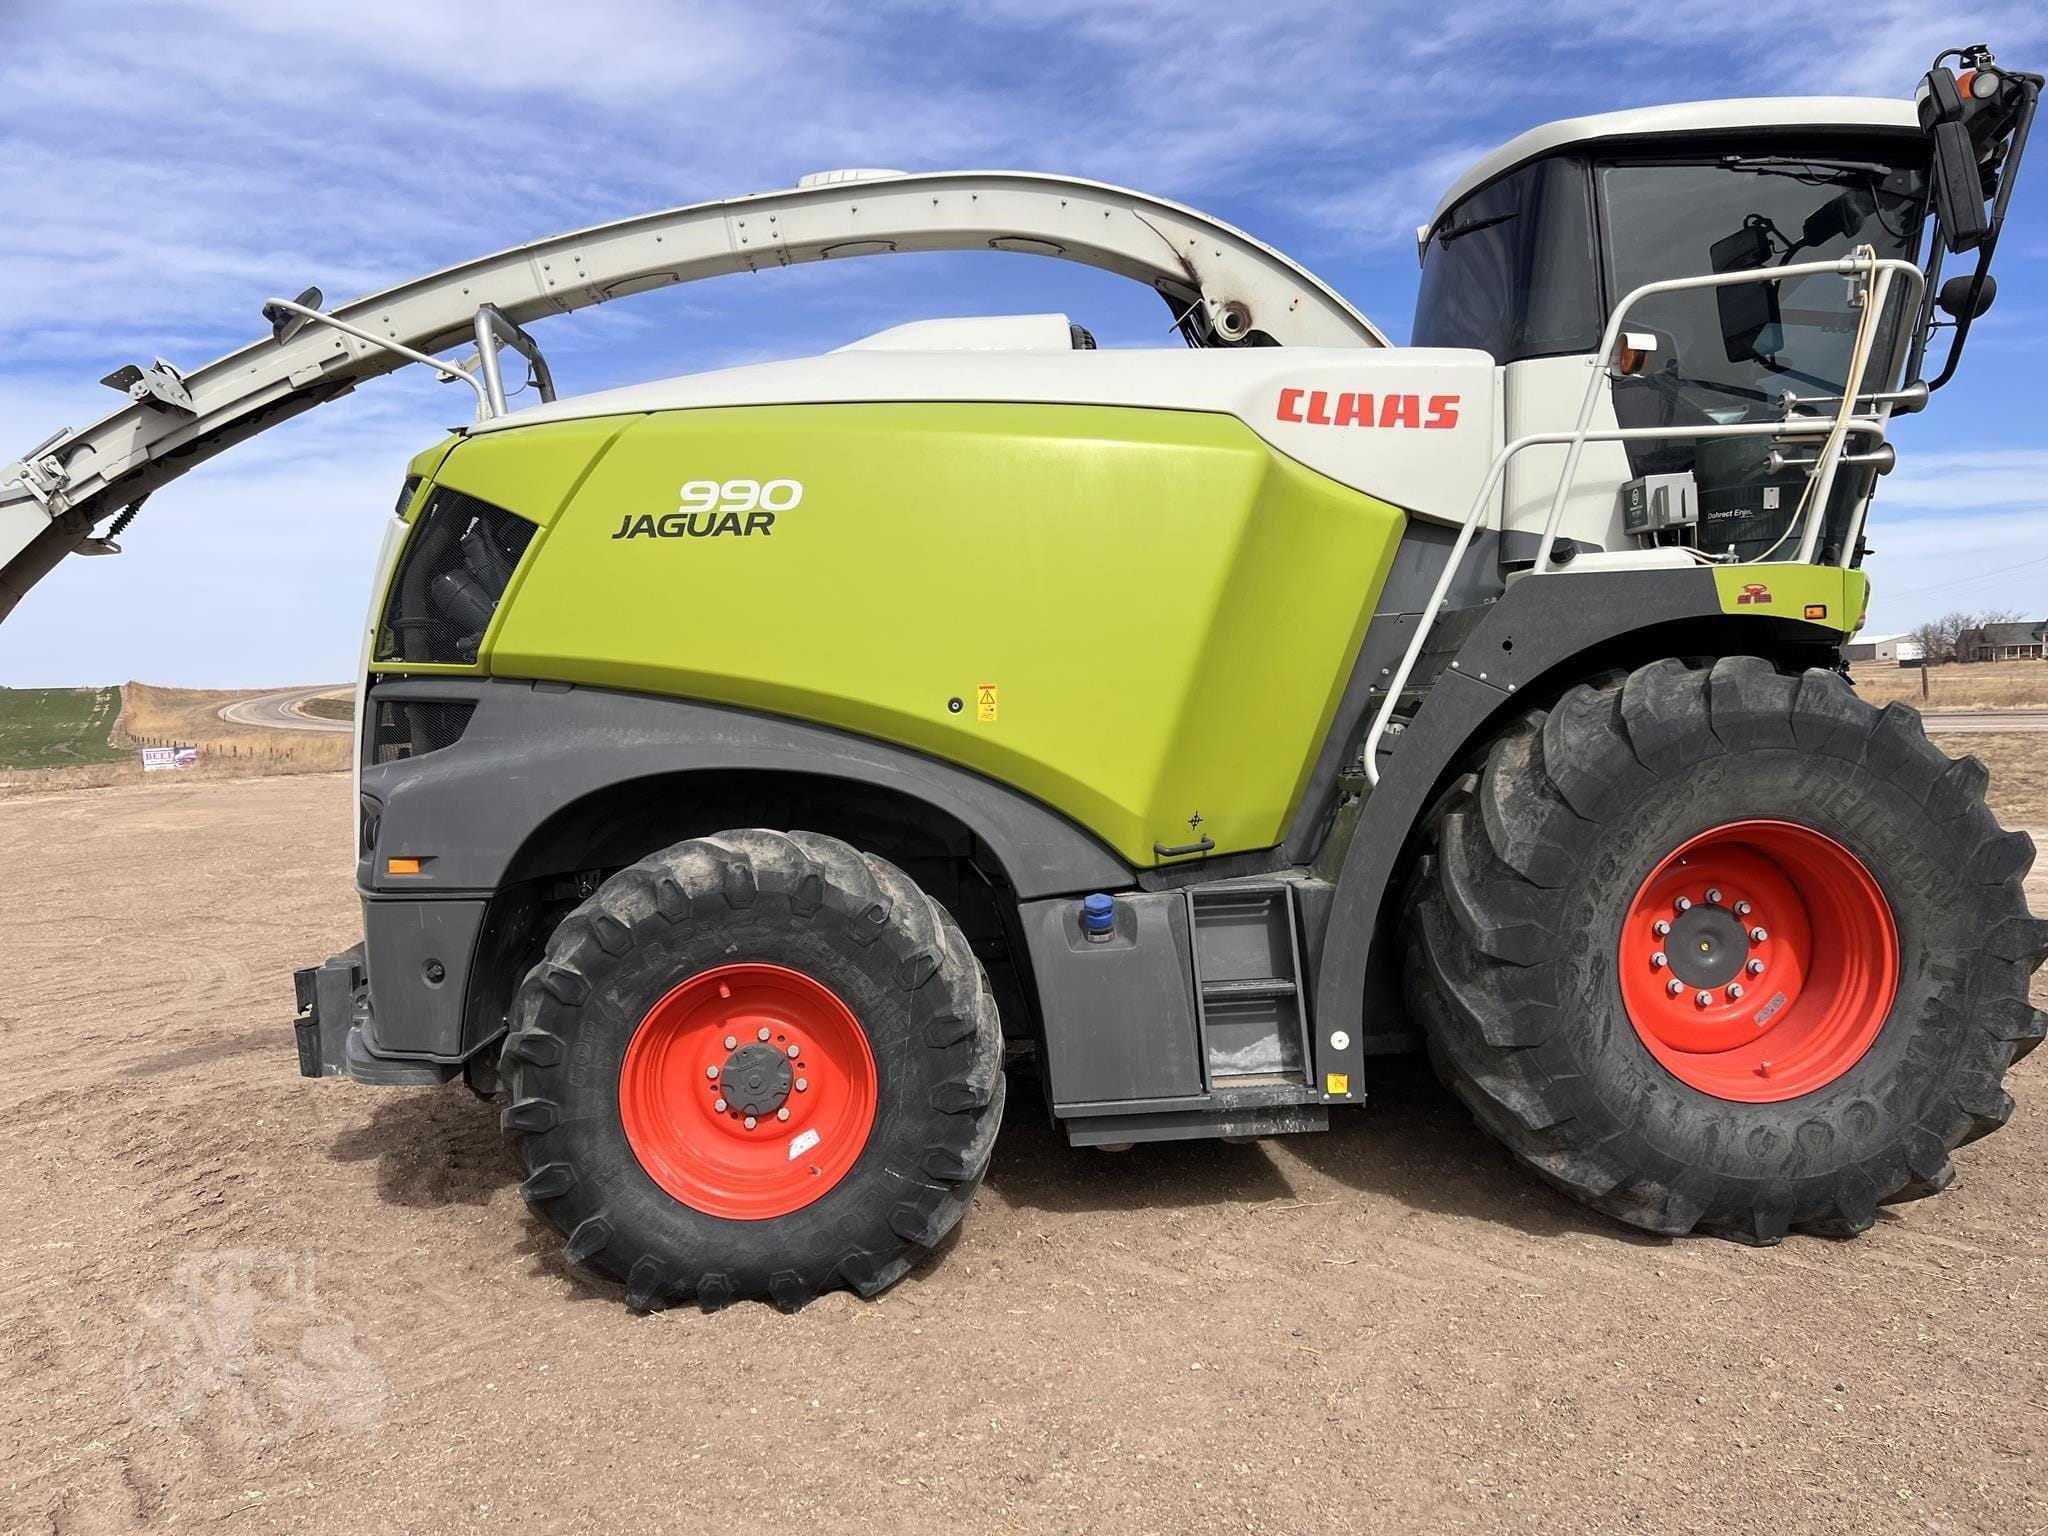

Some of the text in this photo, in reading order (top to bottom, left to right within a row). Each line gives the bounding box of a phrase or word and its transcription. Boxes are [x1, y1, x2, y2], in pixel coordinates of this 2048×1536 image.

[1276, 388, 1460, 429] CLAAS
[678, 479, 804, 513] 990
[611, 512, 776, 539] JAGUAR
[146, 752, 175, 760] BEEF
